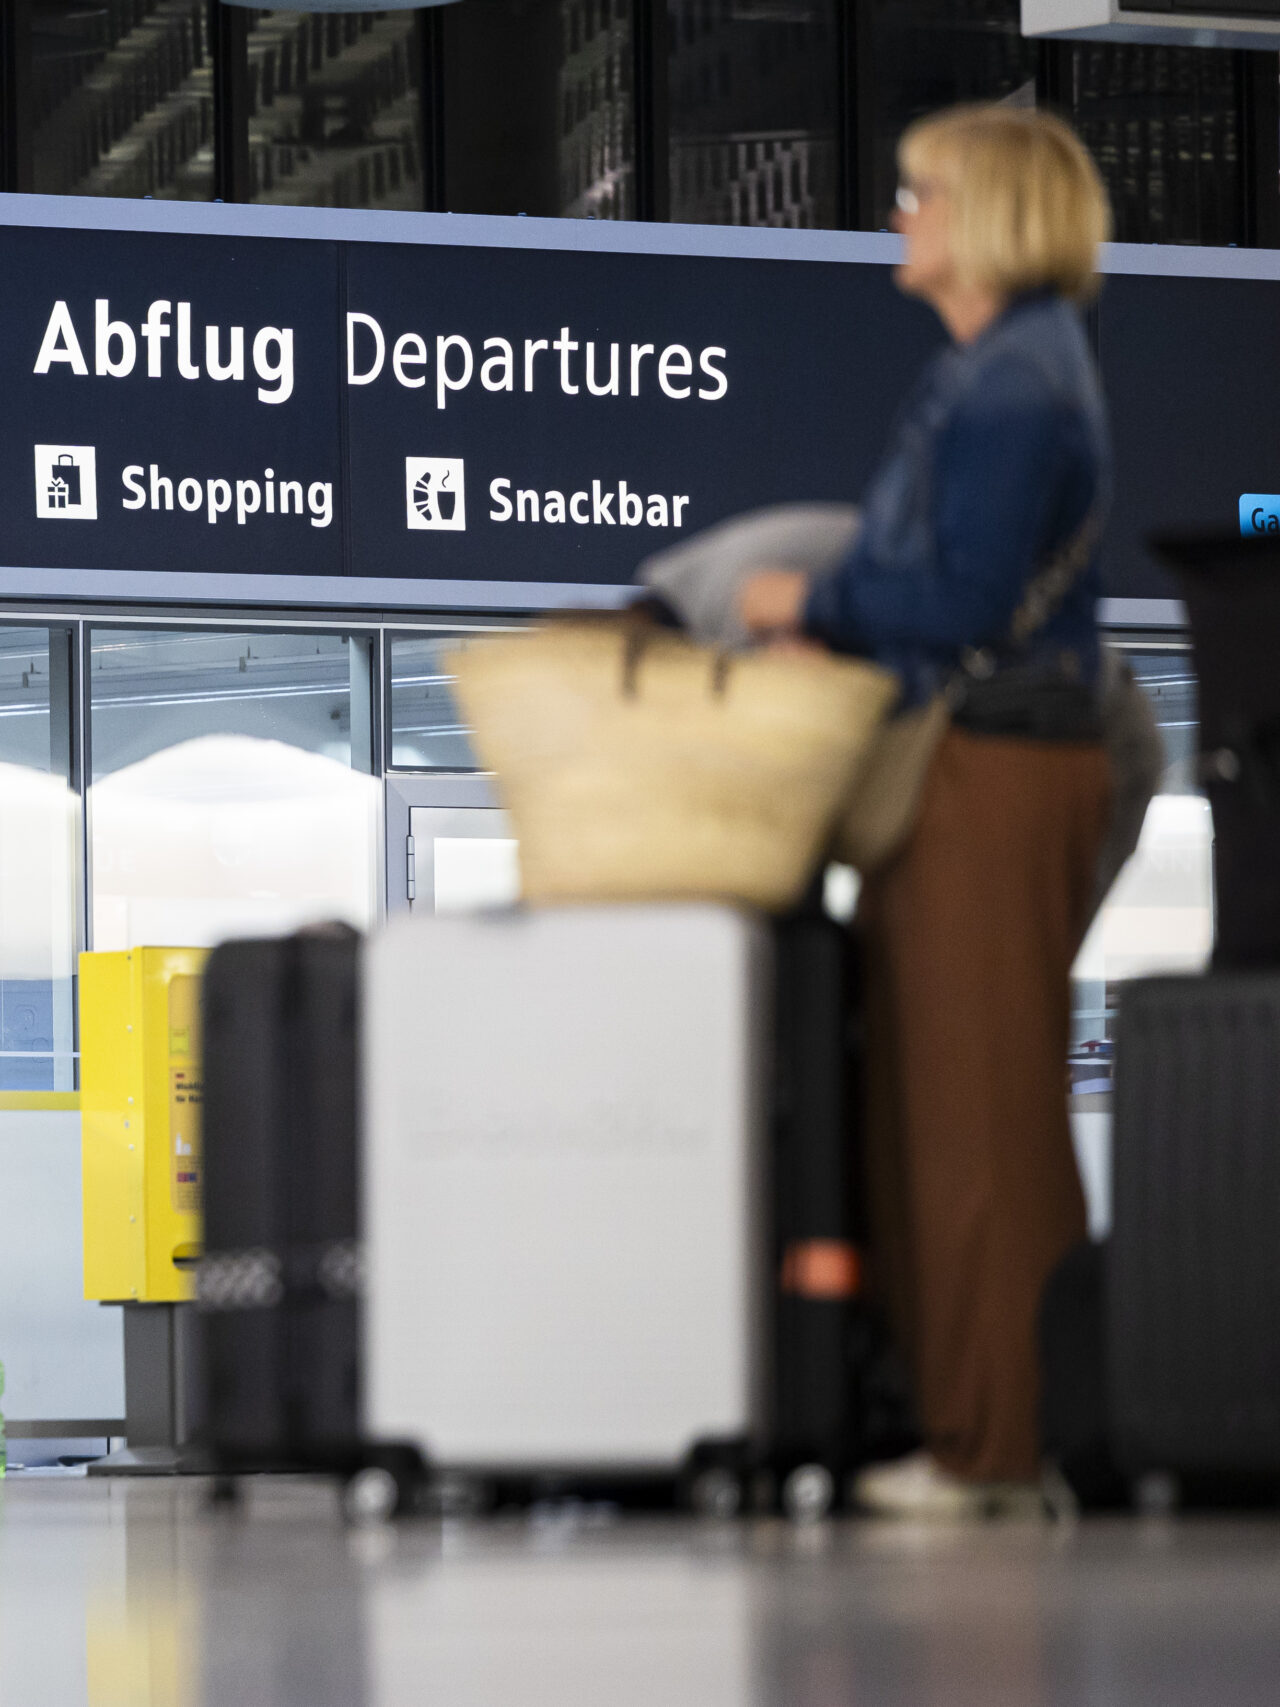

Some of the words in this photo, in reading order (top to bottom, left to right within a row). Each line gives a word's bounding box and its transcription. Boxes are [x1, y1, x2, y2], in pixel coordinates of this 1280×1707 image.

[33, 298, 295, 405] Abflug
[346, 311, 728, 410] Departures
[121, 463, 333, 528] Shopping
[488, 477, 690, 528] Snackbar
